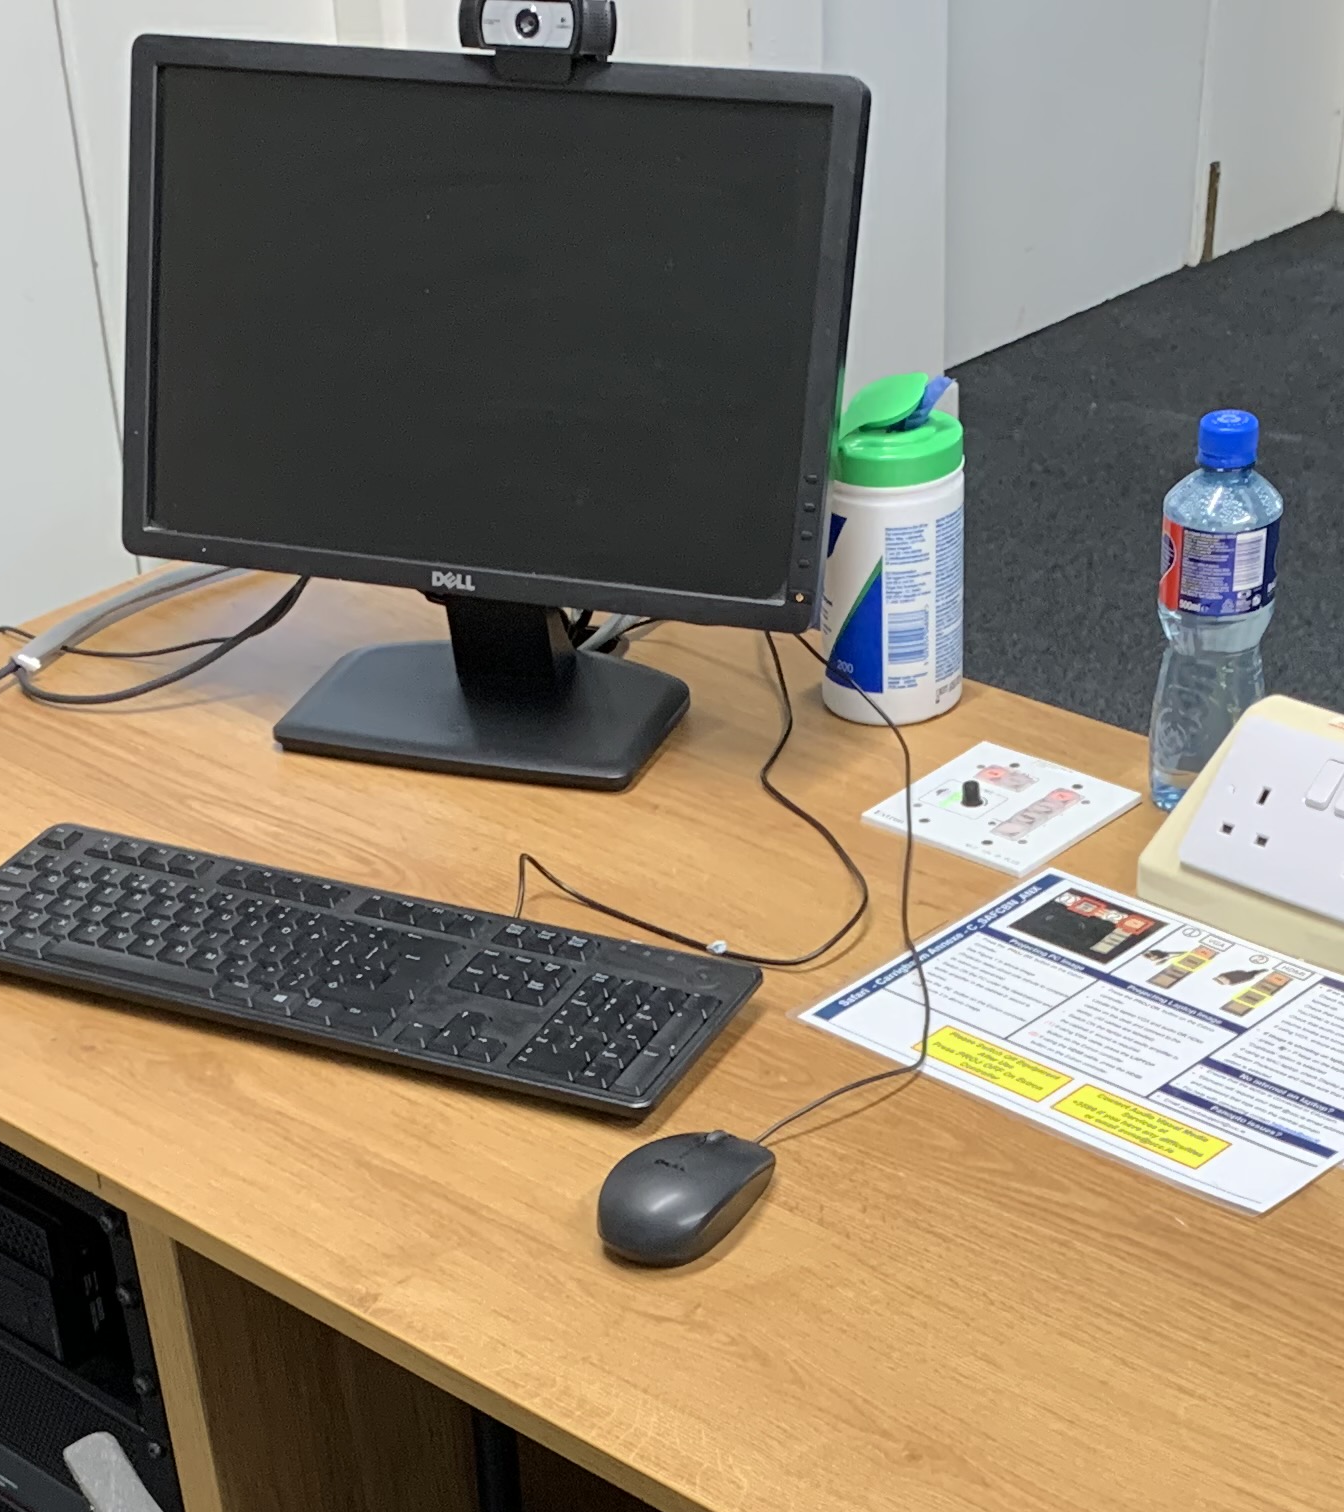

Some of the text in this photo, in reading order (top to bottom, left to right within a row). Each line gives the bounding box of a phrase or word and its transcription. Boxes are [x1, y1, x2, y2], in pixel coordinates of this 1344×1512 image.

[431, 570, 476, 592] DELL
[836, 658, 854, 674] 200
[1006, 938, 1087, 971] Projecting PC Image
[835, 987, 873, 1007] Safari
[924, 931, 966, 954] Annexe
[1123, 984, 1225, 1025] Projecting Laptop Image
[931, 1041, 958, 1053] Press
[1014, 1059, 1062, 1080] Equipment
[1237, 1073, 1255, 1082] No
[1207, 1105, 1249, 1124] Panopto
